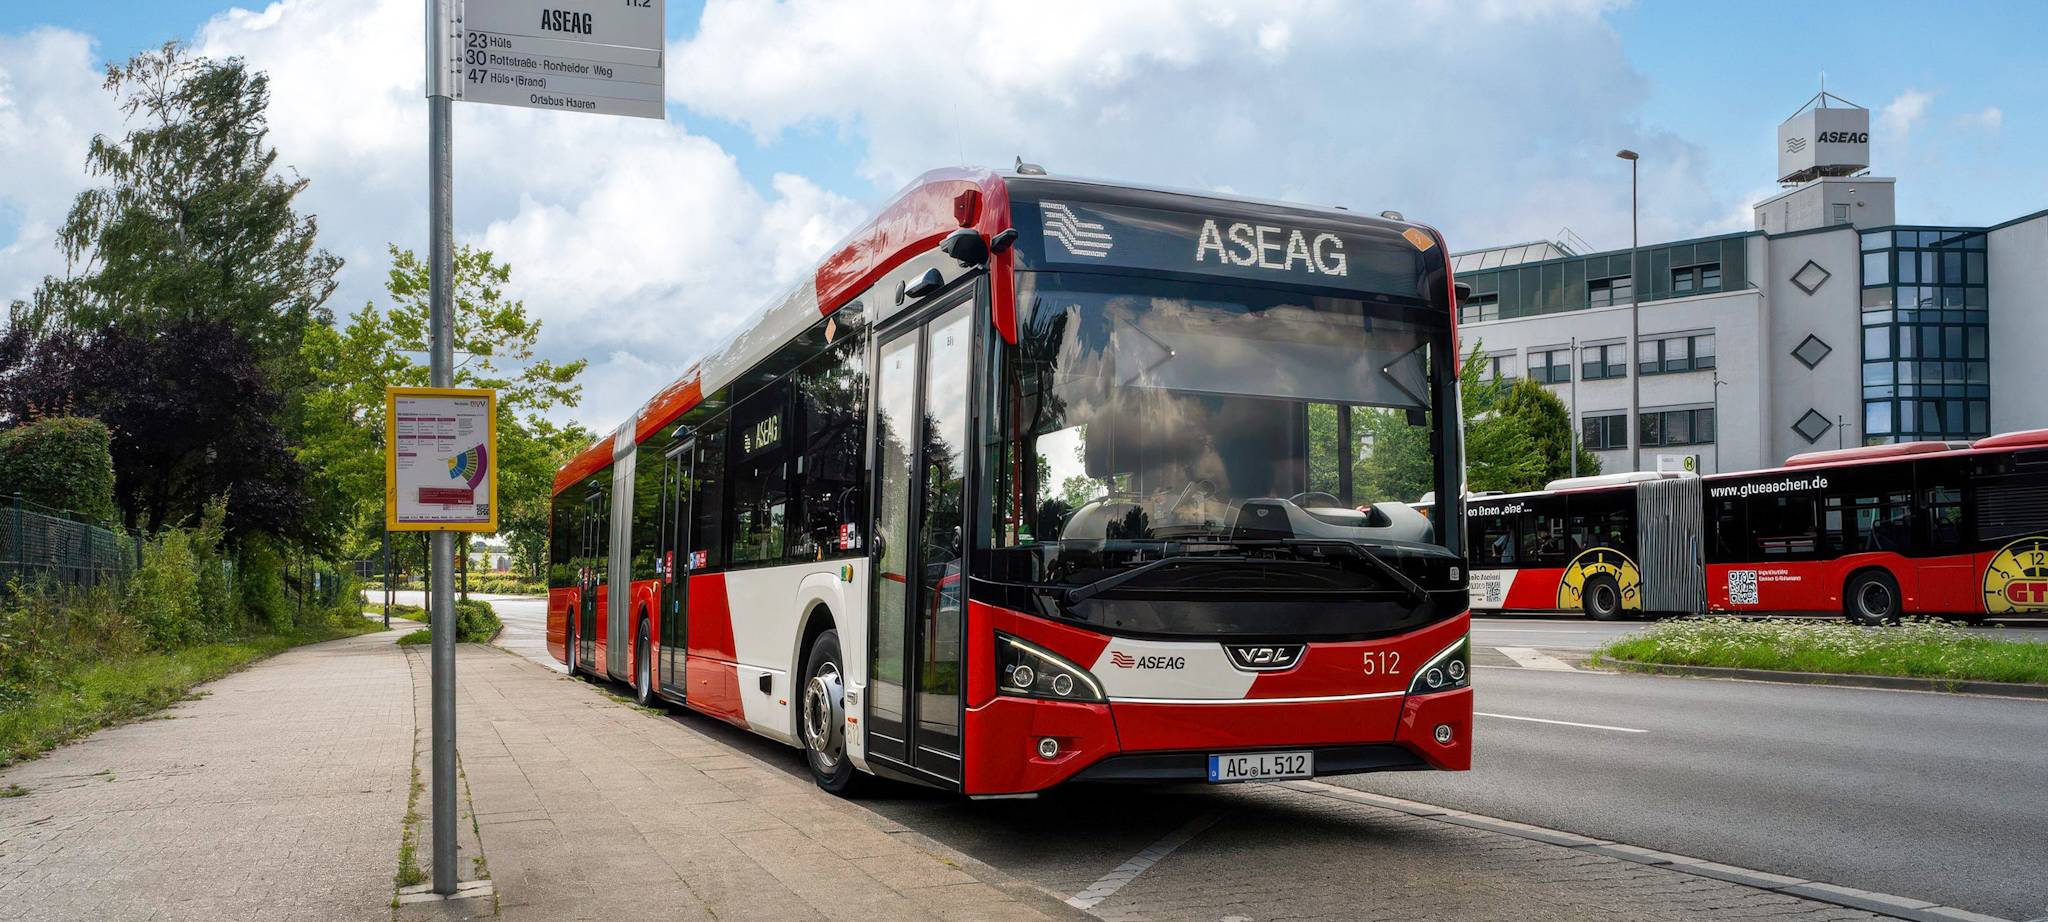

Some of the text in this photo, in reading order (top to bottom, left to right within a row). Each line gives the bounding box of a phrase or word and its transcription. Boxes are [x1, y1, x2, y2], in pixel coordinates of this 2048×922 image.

[541, 9, 592, 34] ASEAG
[468, 32, 512, 49] 23 Hüls
[466, 49, 487, 65] 30
[468, 68, 488, 84] 47
[1817, 131, 1869, 144] ASEAG
[1196, 218, 1348, 277] ASEAG
[755, 415, 778, 449] ASEAG
[1710, 475, 1828, 498] www.gtueaachen.de
[2030, 552, 2045, 566] 12
[1137, 656, 1185, 670] ASEAG
[1238, 648, 1291, 664] VDL
[1363, 651, 1400, 675] 512
[1226, 758, 1248, 777] AC
[1260, 757, 1271, 775] L
[1274, 755, 1305, 775] 512
